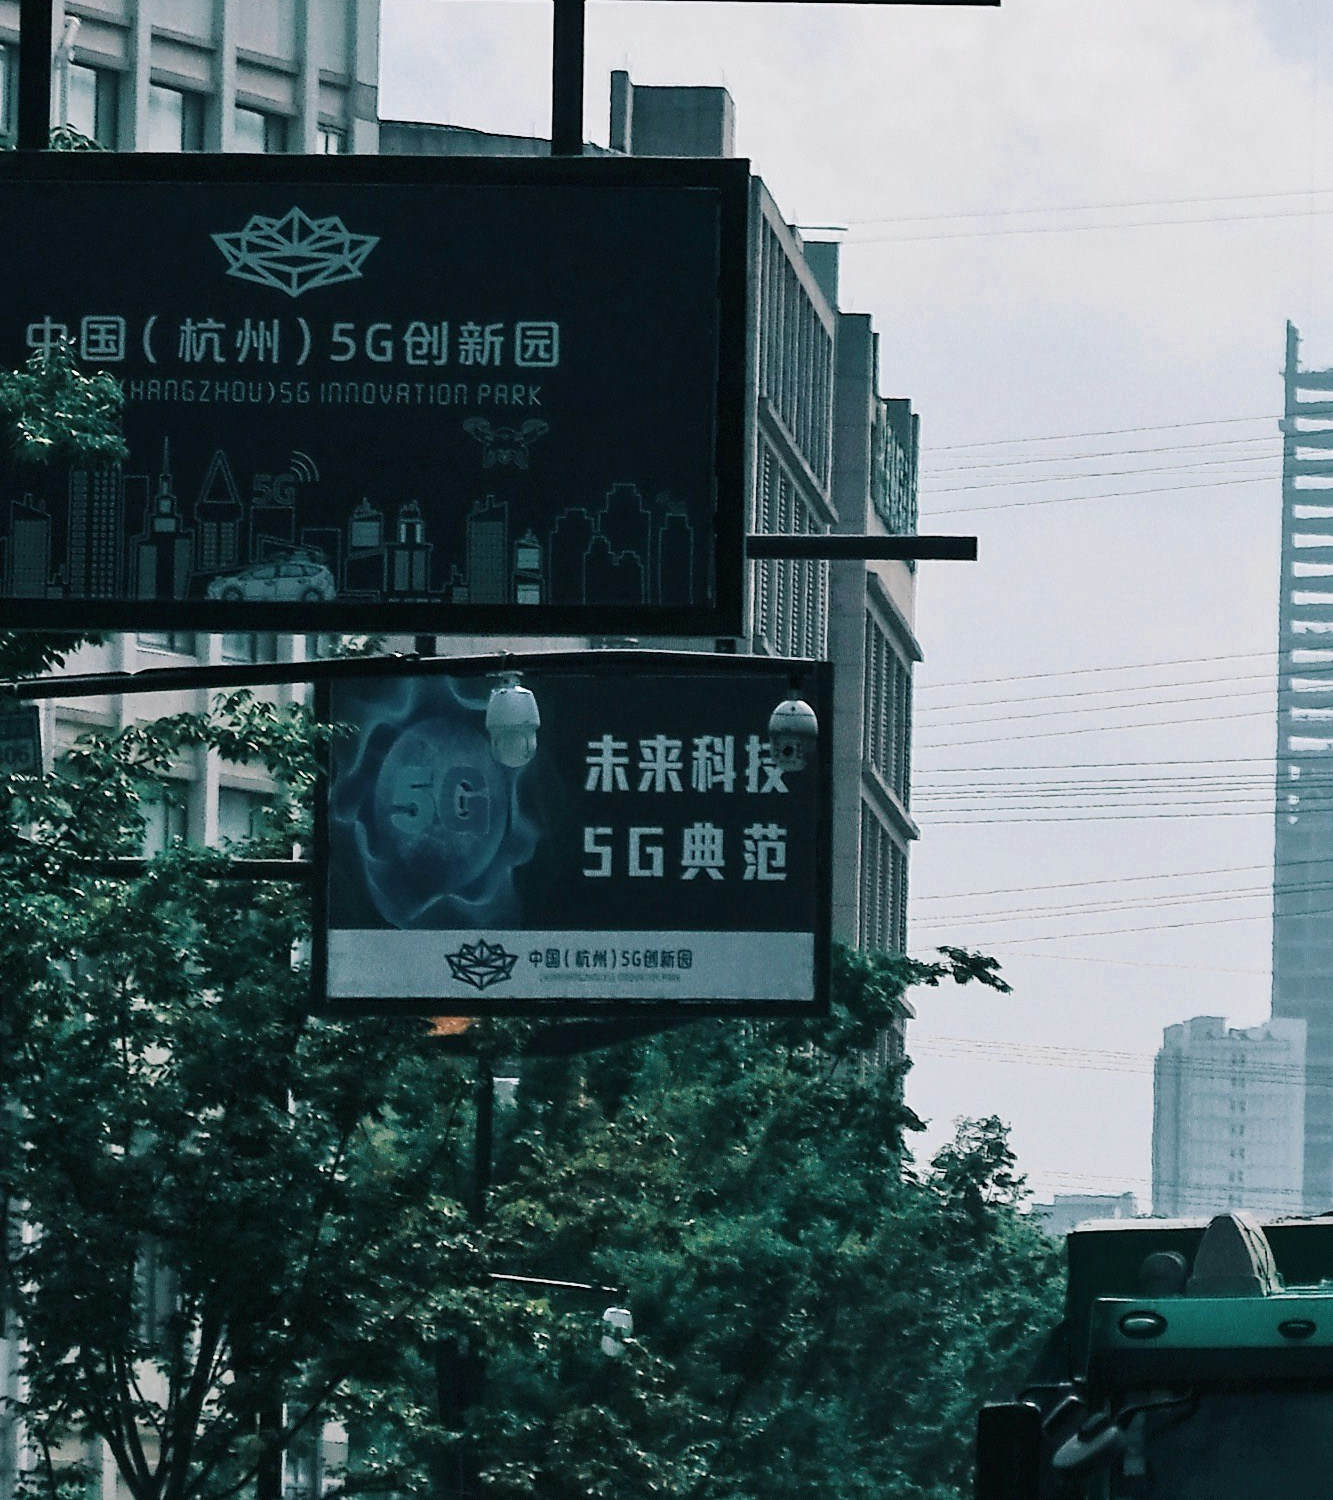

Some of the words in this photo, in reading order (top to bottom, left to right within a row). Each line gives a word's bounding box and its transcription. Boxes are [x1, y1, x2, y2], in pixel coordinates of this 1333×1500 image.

[320, 382, 468, 405] INNOVATION
[478, 384, 542, 405] PARK
[252, 474, 296, 504] 5G
[584, 734, 789, 793] 未来科技
[390, 765, 490, 834] 5G
[582, 822, 787, 881] 5G典范
